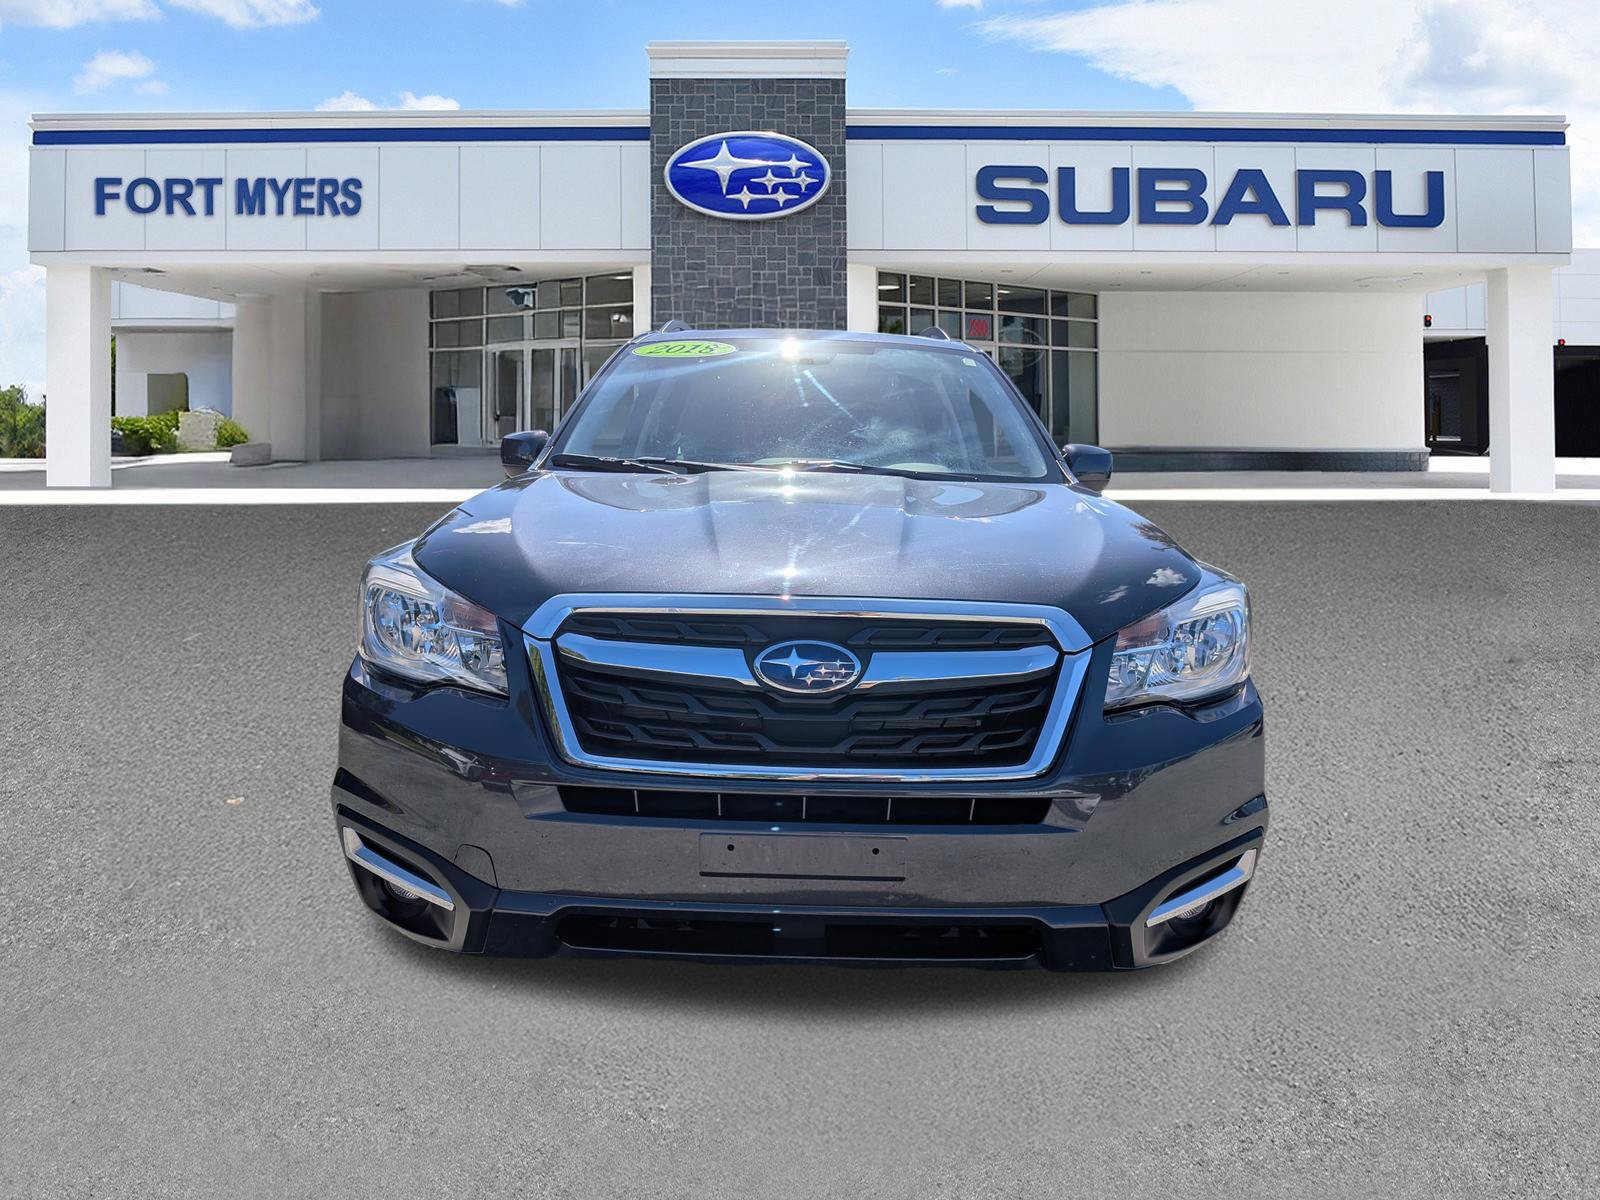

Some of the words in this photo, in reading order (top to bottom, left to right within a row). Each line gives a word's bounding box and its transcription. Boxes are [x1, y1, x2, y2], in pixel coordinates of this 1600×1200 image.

[94, 177, 223, 216] FORT
[235, 177, 363, 217] MYERS
[975, 164, 1446, 229] SUBARU
[647, 344, 719, 354] 2018
